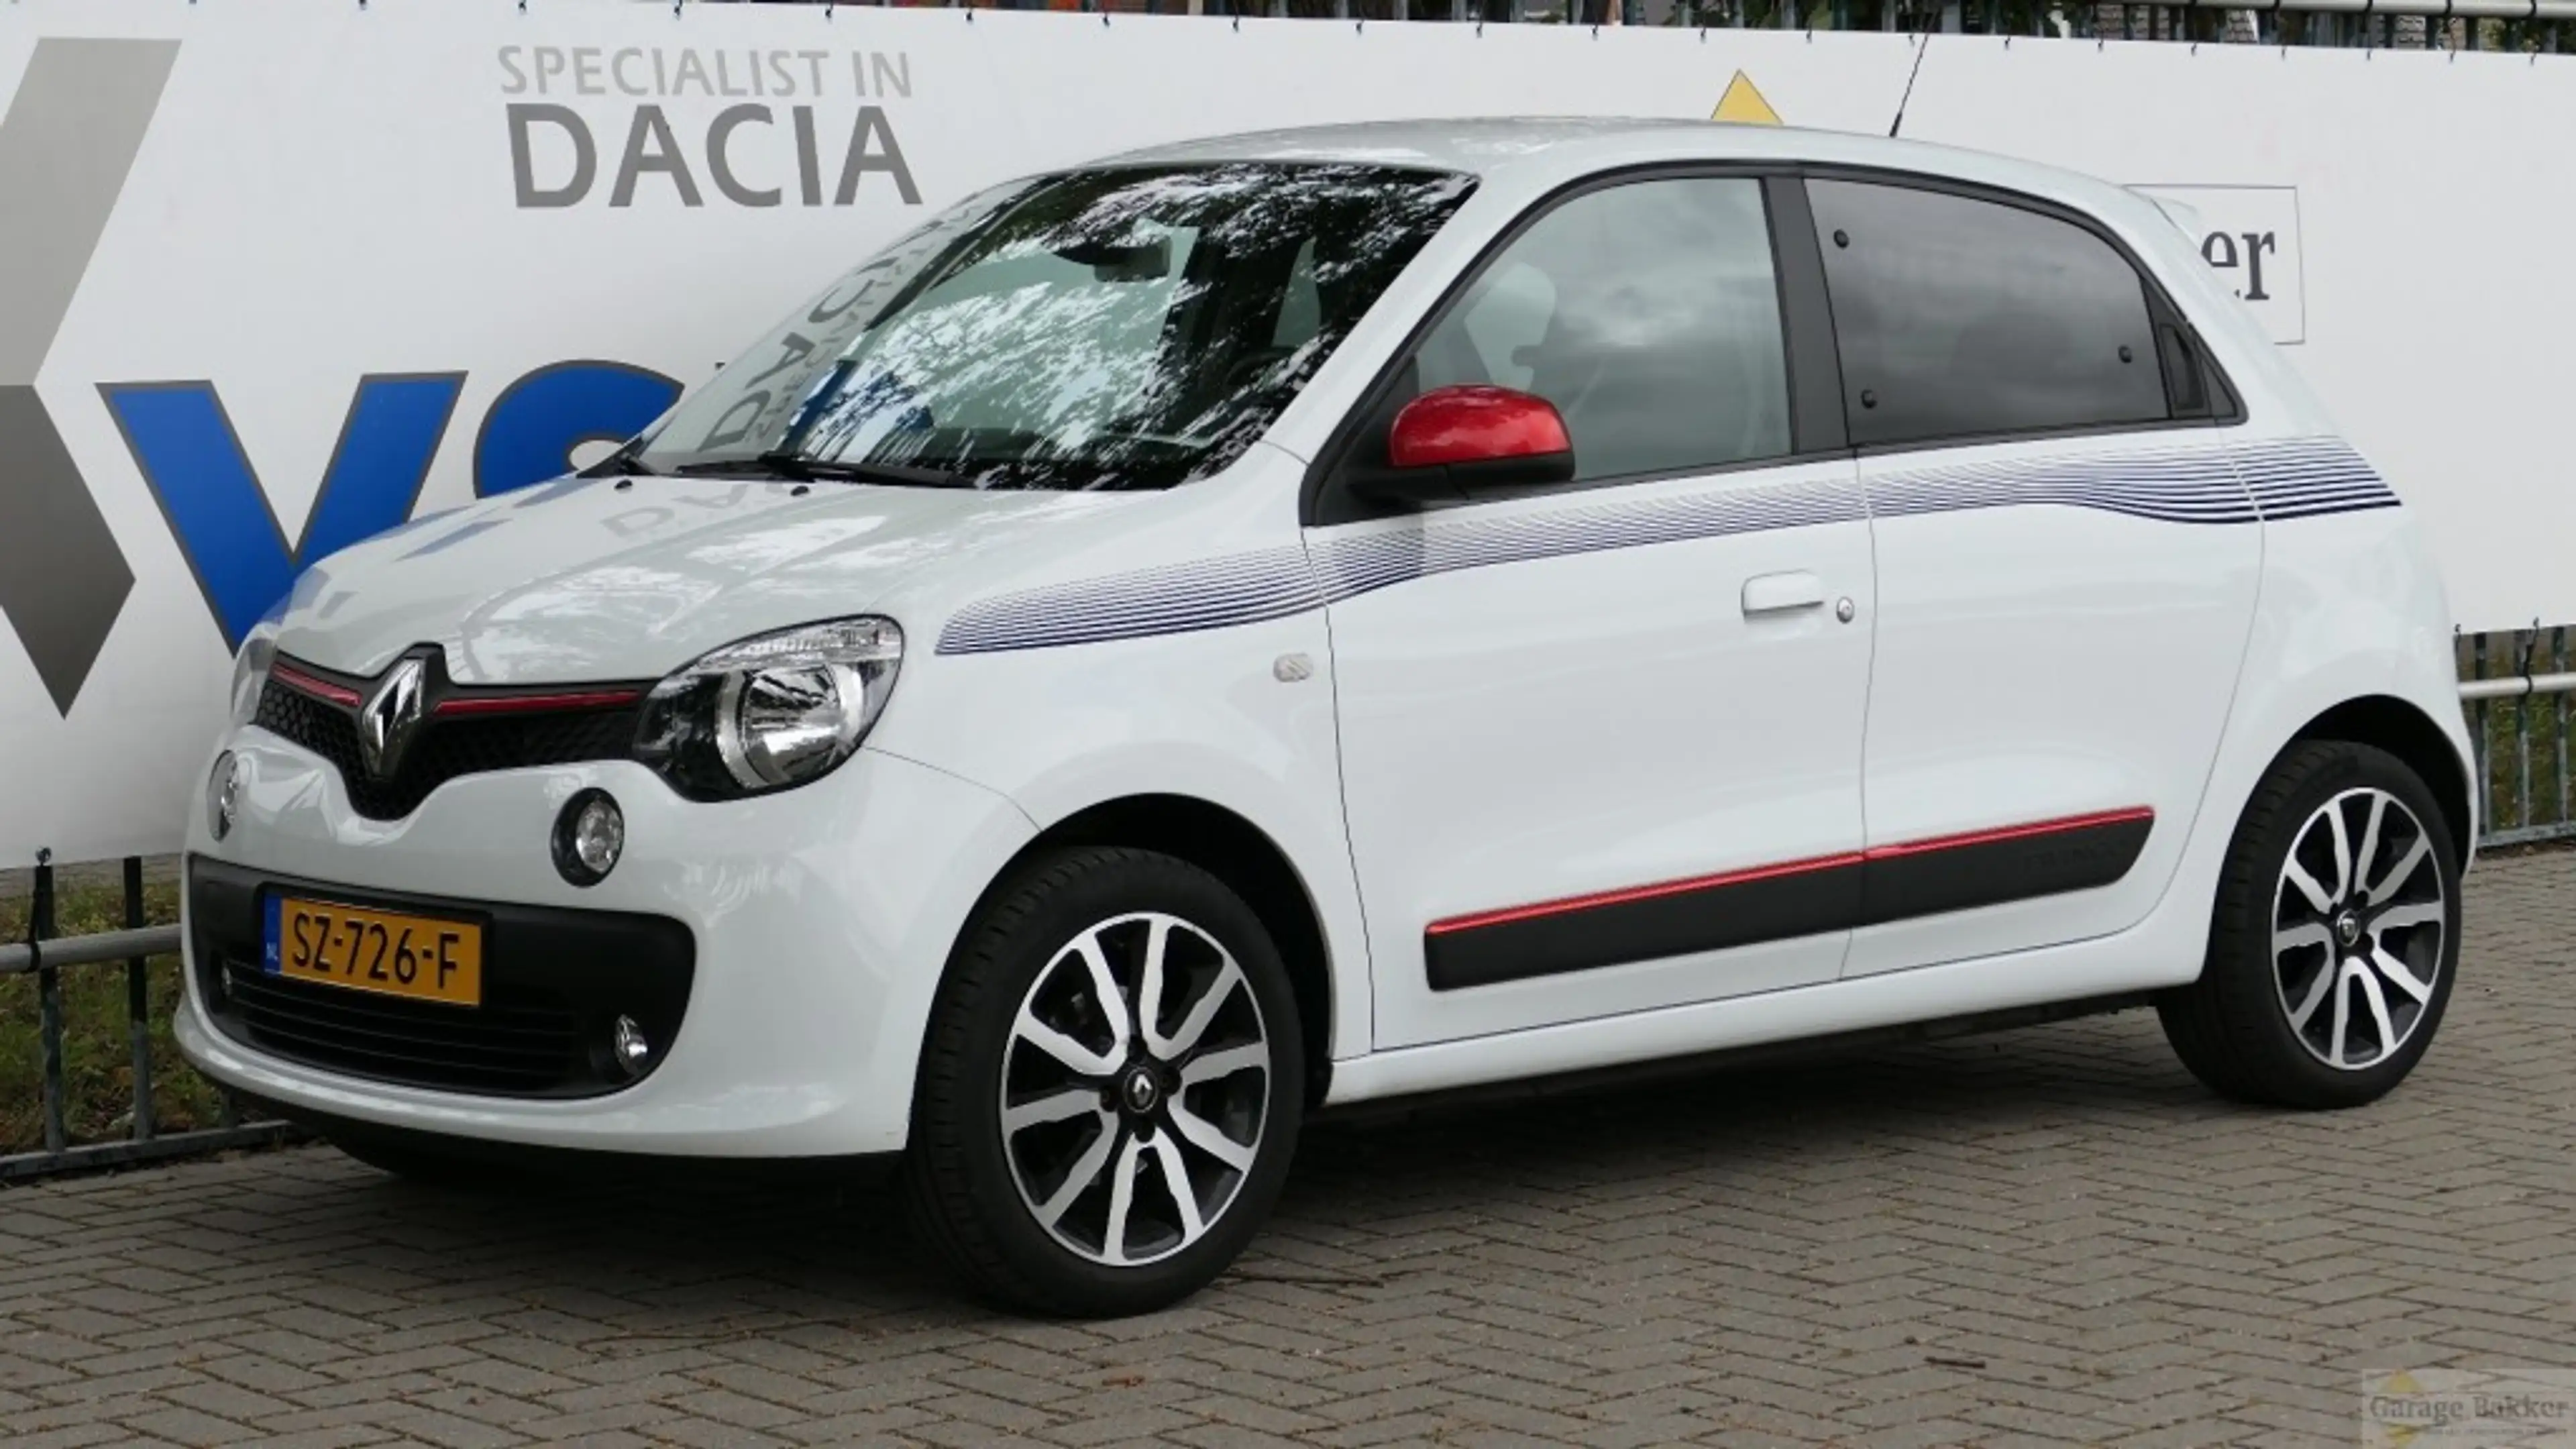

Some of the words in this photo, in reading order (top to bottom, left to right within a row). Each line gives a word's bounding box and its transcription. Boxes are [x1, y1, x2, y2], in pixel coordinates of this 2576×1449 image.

[498, 46, 829, 97] SPECIALIST
[851, 50, 912, 99] IN
[506, 102, 924, 208] DACIA
[291, 911, 461, 990] SZ-726-F
